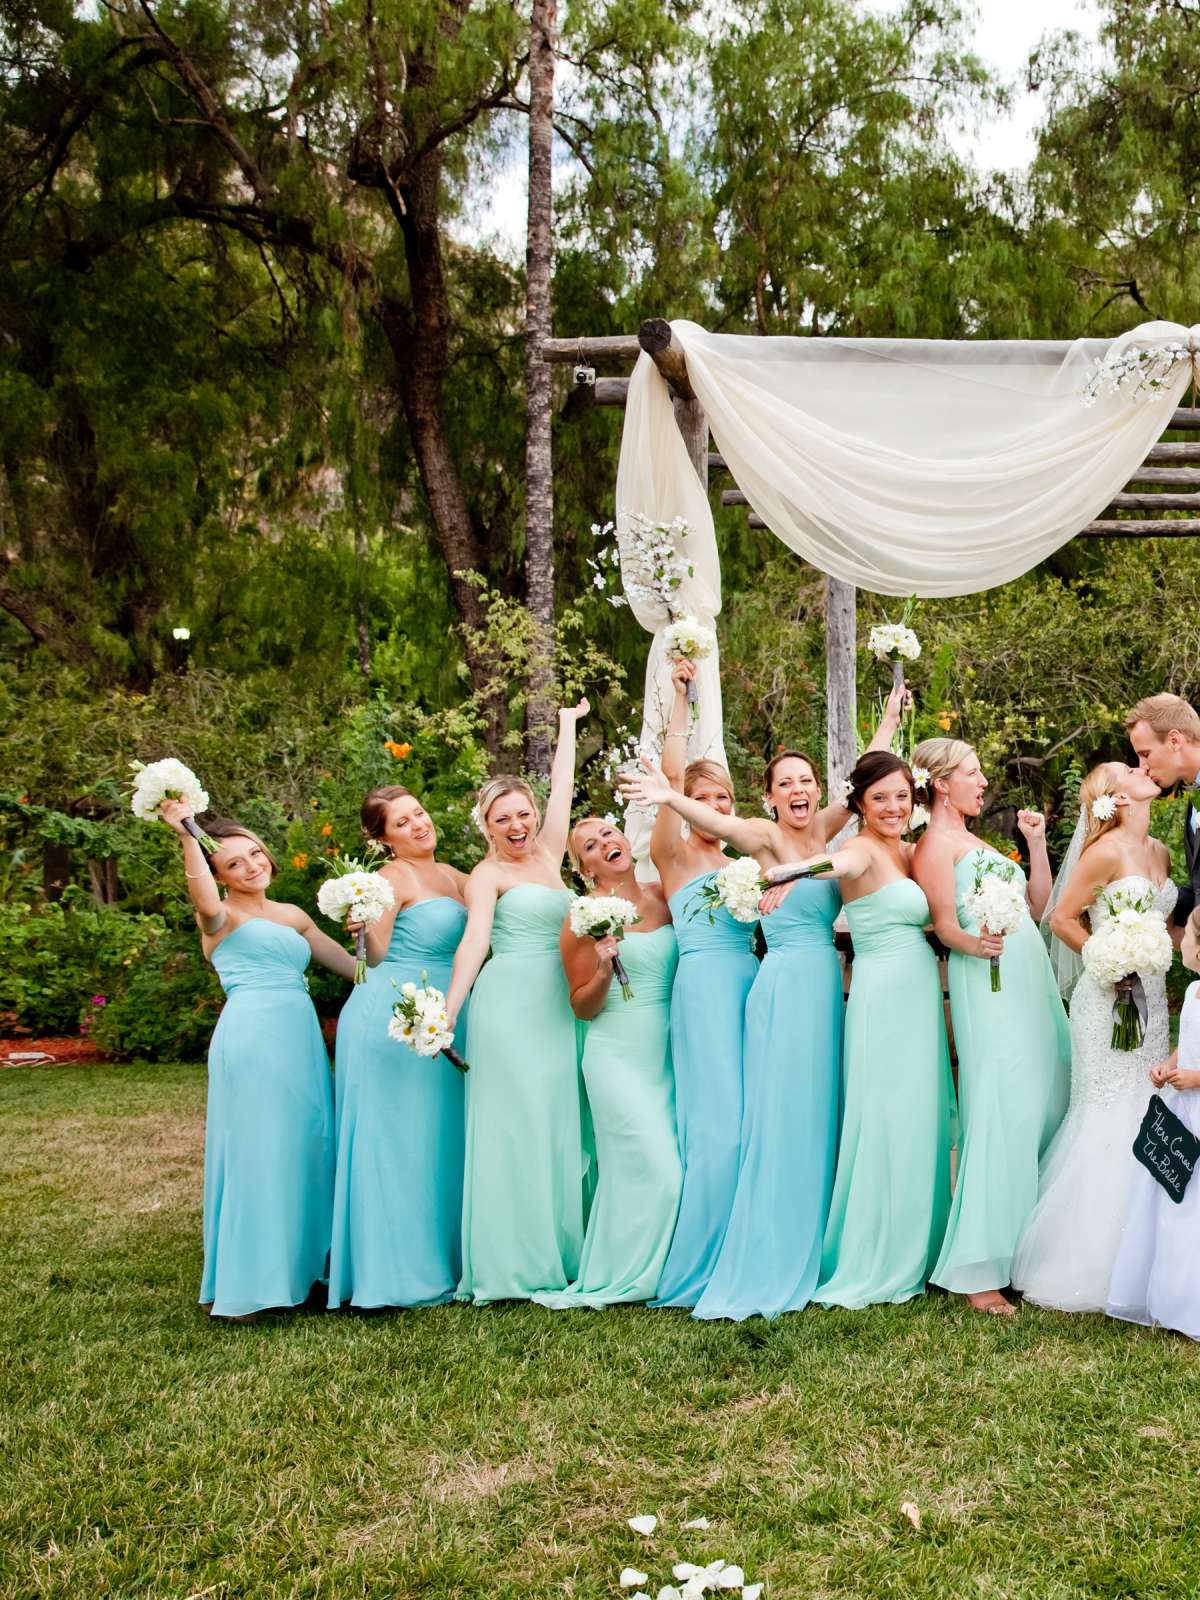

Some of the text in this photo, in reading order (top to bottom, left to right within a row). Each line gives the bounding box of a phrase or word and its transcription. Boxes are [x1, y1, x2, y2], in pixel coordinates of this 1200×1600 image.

[1143, 1131, 1180, 1193] The Bride
[1151, 1104, 1194, 1172] Here Comes
